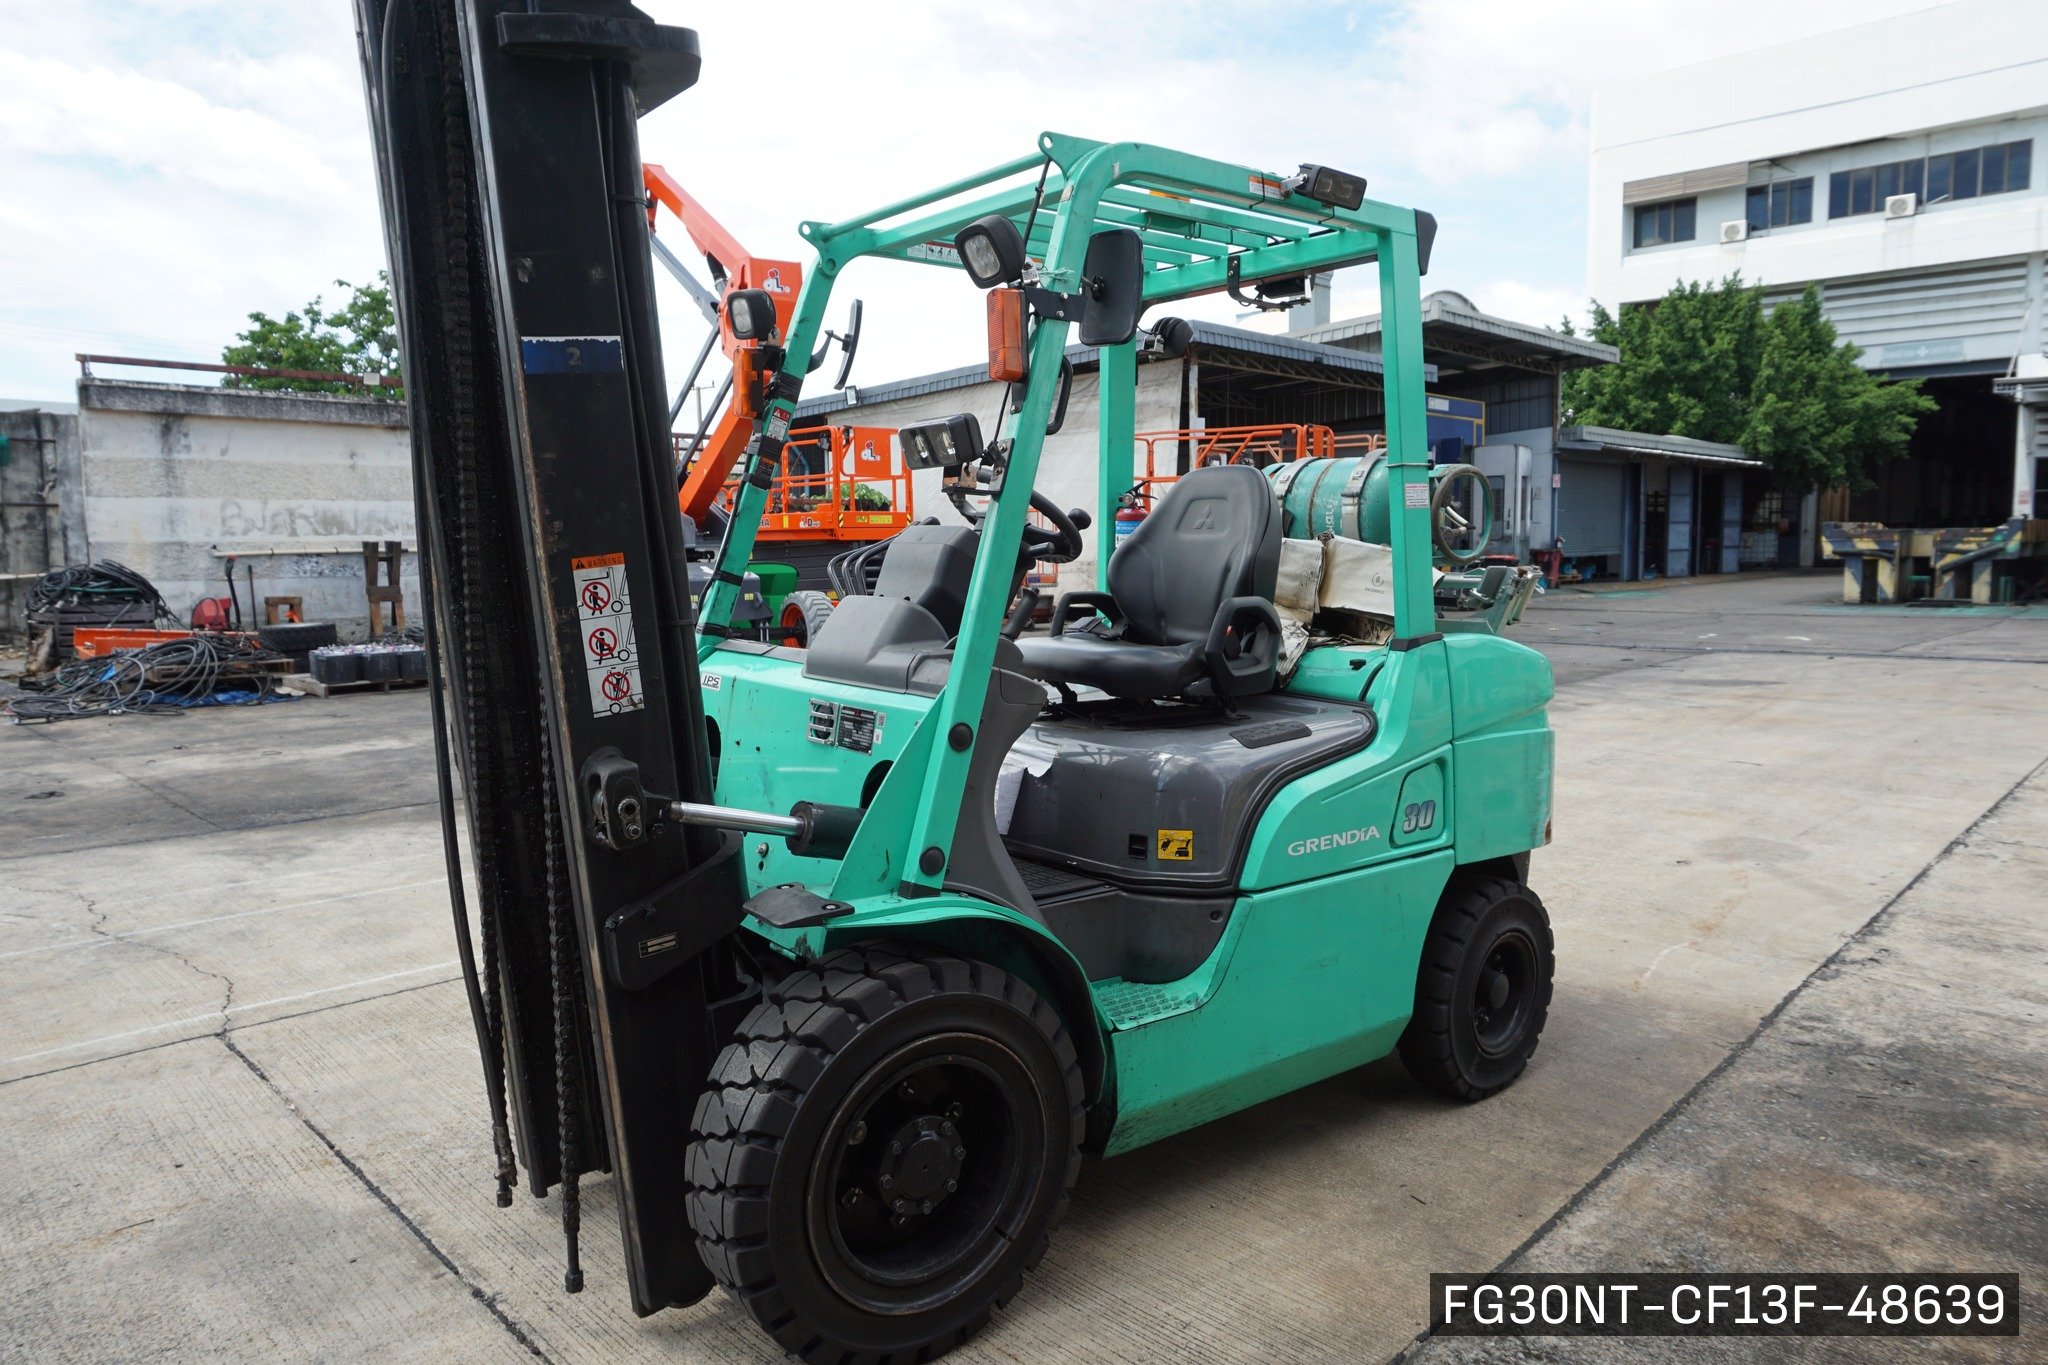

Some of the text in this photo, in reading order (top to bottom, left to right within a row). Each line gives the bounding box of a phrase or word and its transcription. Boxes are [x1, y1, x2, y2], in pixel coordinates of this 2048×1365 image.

[566, 346, 582, 366] 2
[587, 555, 622, 569] WARNING
[703, 674, 720, 686] IPS
[1402, 799, 1436, 834] 30
